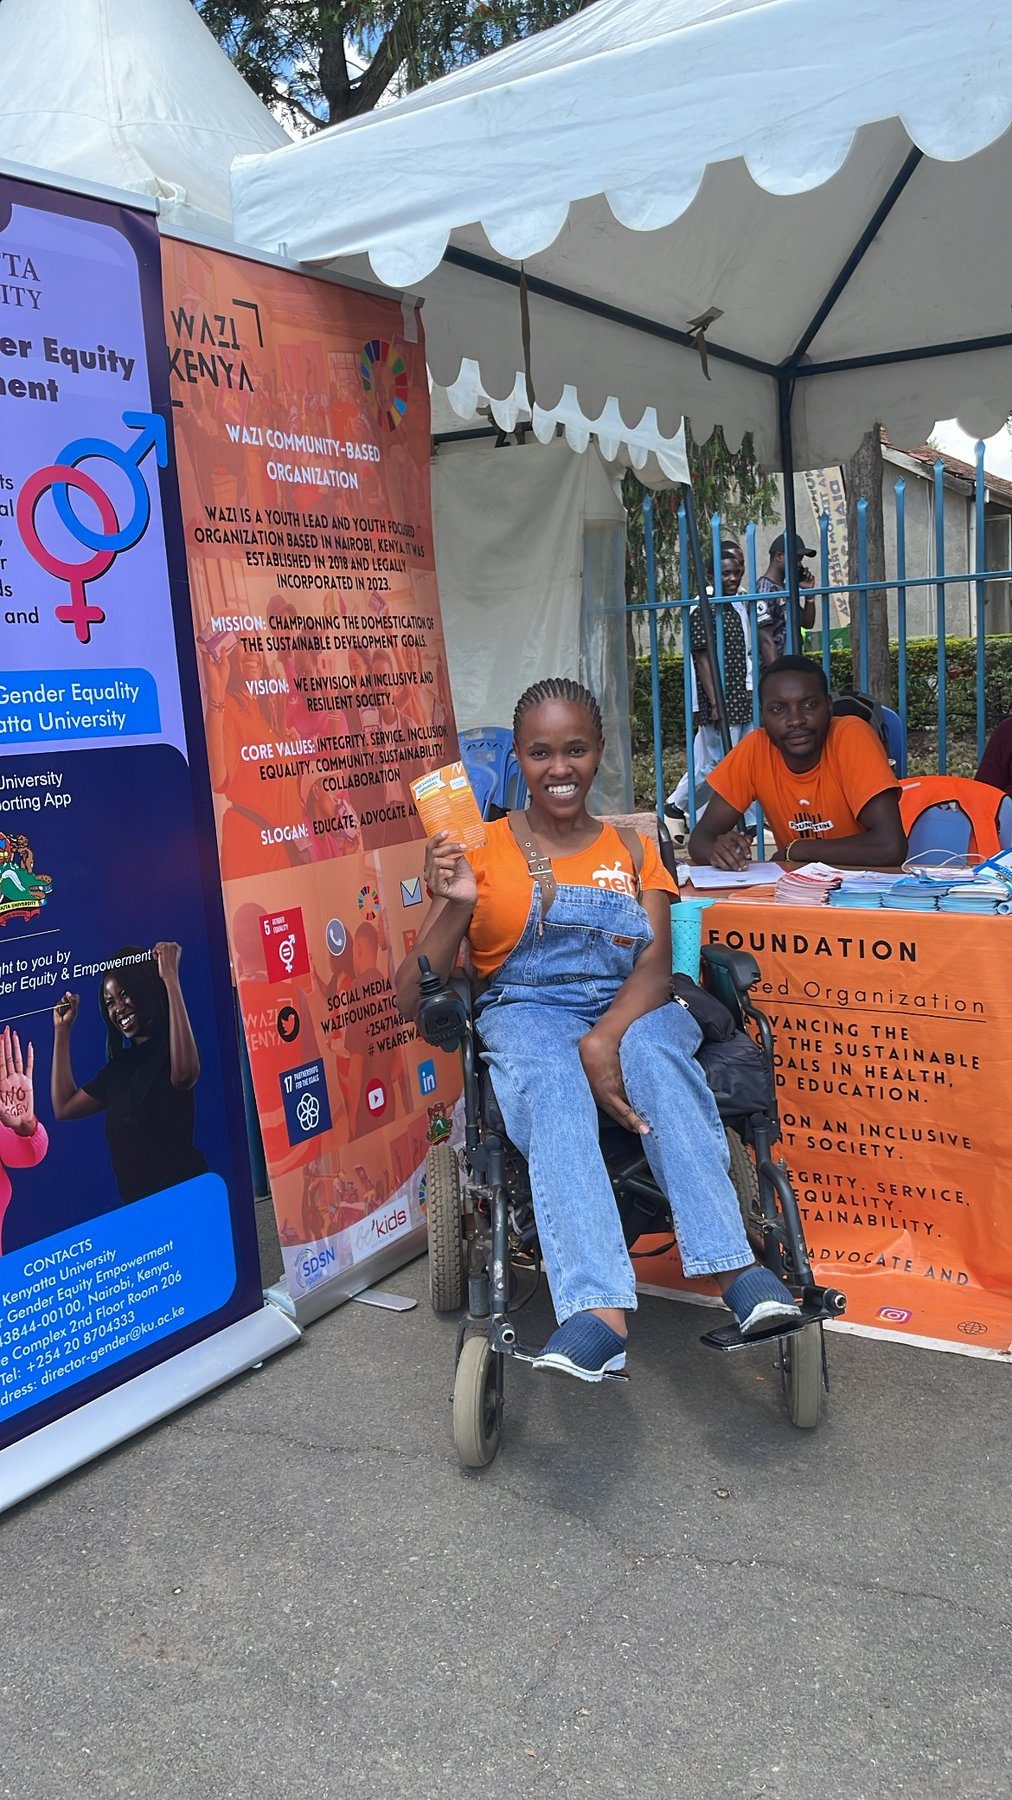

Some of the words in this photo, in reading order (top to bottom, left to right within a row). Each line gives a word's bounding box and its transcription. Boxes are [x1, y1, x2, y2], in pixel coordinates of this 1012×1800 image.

[0, 252, 41, 282] TA
[171, 306, 240, 350] WAZI
[43, 337, 135, 381] Equity
[167, 345, 254, 392] KENYA
[225, 424, 263, 446] WAZI
[266, 430, 381, 463] COMMUNITY-BASED
[266, 461, 359, 489] ORGANIZATION
[205, 506, 237, 522] WAZI
[240, 508, 251, 523] IS
[255, 509, 263, 523] A
[265, 510, 300, 527] YOUTH
[302, 513, 328, 529] LEAD
[332, 516, 350, 530] AND
[352, 518, 386, 533] YOUTH
[388, 521, 415, 538] FOCUSED
[194, 527, 284, 546] ORGANIZATION
[286, 532, 318, 549] BASED
[321, 535, 332, 549] IN
[334, 536, 376, 553] NAIROBI,
[405, 542, 412, 554] IT
[412, 545, 425, 558] WAS
[245, 551, 311, 569] ESTABLISHED
[314, 555, 325, 569] IN
[328, 556, 348, 570] 2018
[351, 558, 369, 571] AND
[372, 558, 407, 573] LEGALLY
[276, 573, 353, 590] INCORPORATED
[355, 576, 365, 590] IN
[367, 577, 391, 590] 2023.
[5, 606, 39, 624] and
[211, 615, 266, 632] MISSION:
[269, 616, 340, 631] CHAMPIONING
[342, 616, 360, 630] THE
[361, 615, 427, 630] DOMESTICATION
[427, 617, 434, 630] OF
[240, 637, 263, 652] THE
[266, 636, 331, 651] SUSTAINABLE
[334, 635, 398, 650] DEVELOPMENT
[401, 634, 427, 648] GOALS.
[0, 683, 65, 704] Gender
[71, 681, 139, 705] Equality
[245, 678, 290, 696] VISION:
[294, 678, 308, 691] WE
[311, 675, 357, 691] ENVISION
[360, 674, 372, 688] AN
[373, 671, 418, 687] INCLUSIVE
[420, 671, 434, 684] AND
[307, 695, 353, 712] RESILIENT
[355, 692, 394, 708] SOCIETY.
[38, 709, 126, 730] University
[241, 743, 274, 761] CORE
[275, 739, 316, 757] VALUES:
[317, 733, 369, 752] INTEGRITY.
[370, 730, 405, 746] SERVICE.
[407, 725, 449, 741] INCLUSION
[259, 760, 314, 780] EQUALITY.
[316, 752, 378, 772] COMMUNITY.
[380, 743, 446, 764] SUSTAINABILITY.
[323, 768, 401, 792] COLLABORATION
[0, 795, 41, 812] orting
[44, 792, 72, 808] App
[261, 822, 309, 845] SLOGAN:
[313, 814, 358, 835] EDUCATE,
[360, 805, 406, 826] ADVOCATE
[264, 920, 271, 935] 5
[709, 929, 917, 962] FOUNDATION
[16, 959, 28, 972] to
[31, 954, 53, 972] you
[56, 950, 71, 965] by
[20, 971, 58, 990] Equity
[61, 967, 70, 981] &
[73, 949, 152, 978] Empowerment
[327, 987, 361, 1012] SOCIAL
[362, 977, 392, 999] MEDIA
[804, 980, 984, 1014] Organization
[871, 1025, 910, 1041] THE
[789, 1037, 823, 1053] THE
[834, 1042, 980, 1070] SUSTAINABLE
[284, 1074, 292, 1094] 17
[422, 1071, 435, 1092] in
[832, 1061, 851, 1076] IN
[865, 1065, 954, 1088] HEALTH,
[797, 1078, 929, 1103] EDUCATION.
[808, 1136, 904, 1160] SOCIETY.
[823, 1120, 848, 1134] AN
[860, 1123, 972, 1149] INCLUSIVE
[877, 1182, 970, 1206] SERVICE.
[23, 1238, 93, 1277] CONTACTS
[303, 1246, 336, 1277] SDSN
[807, 1247, 913, 1272] ADVOCATE
[924, 1265, 969, 1286] AND
[2, 1275, 56, 1307] Kenyatta
[59, 1249, 117, 1281] University
[7, 1296, 54, 1323] Gender
[57, 1278, 93, 1302] Equity
[95, 1240, 174, 1284] Empowerment
[88, 1276, 134, 1305] Nairobi,
[137, 1261, 173, 1283] Kenya.
[12, 1328, 67, 1360] Complex
[70, 1312, 93, 1334] 2nd
[95, 1300, 125, 1320] Floor
[128, 1284, 159, 1305] Room
[161, 1270, 182, 1290] 206
[0, 1366, 21, 1386] Tel:
[26, 1346, 61, 1372] +254
[64, 1337, 80, 1355] 20
[83, 1310, 135, 1345] 8704333
[41, 1306, 185, 1386] director-gender@ku.ac.ke
